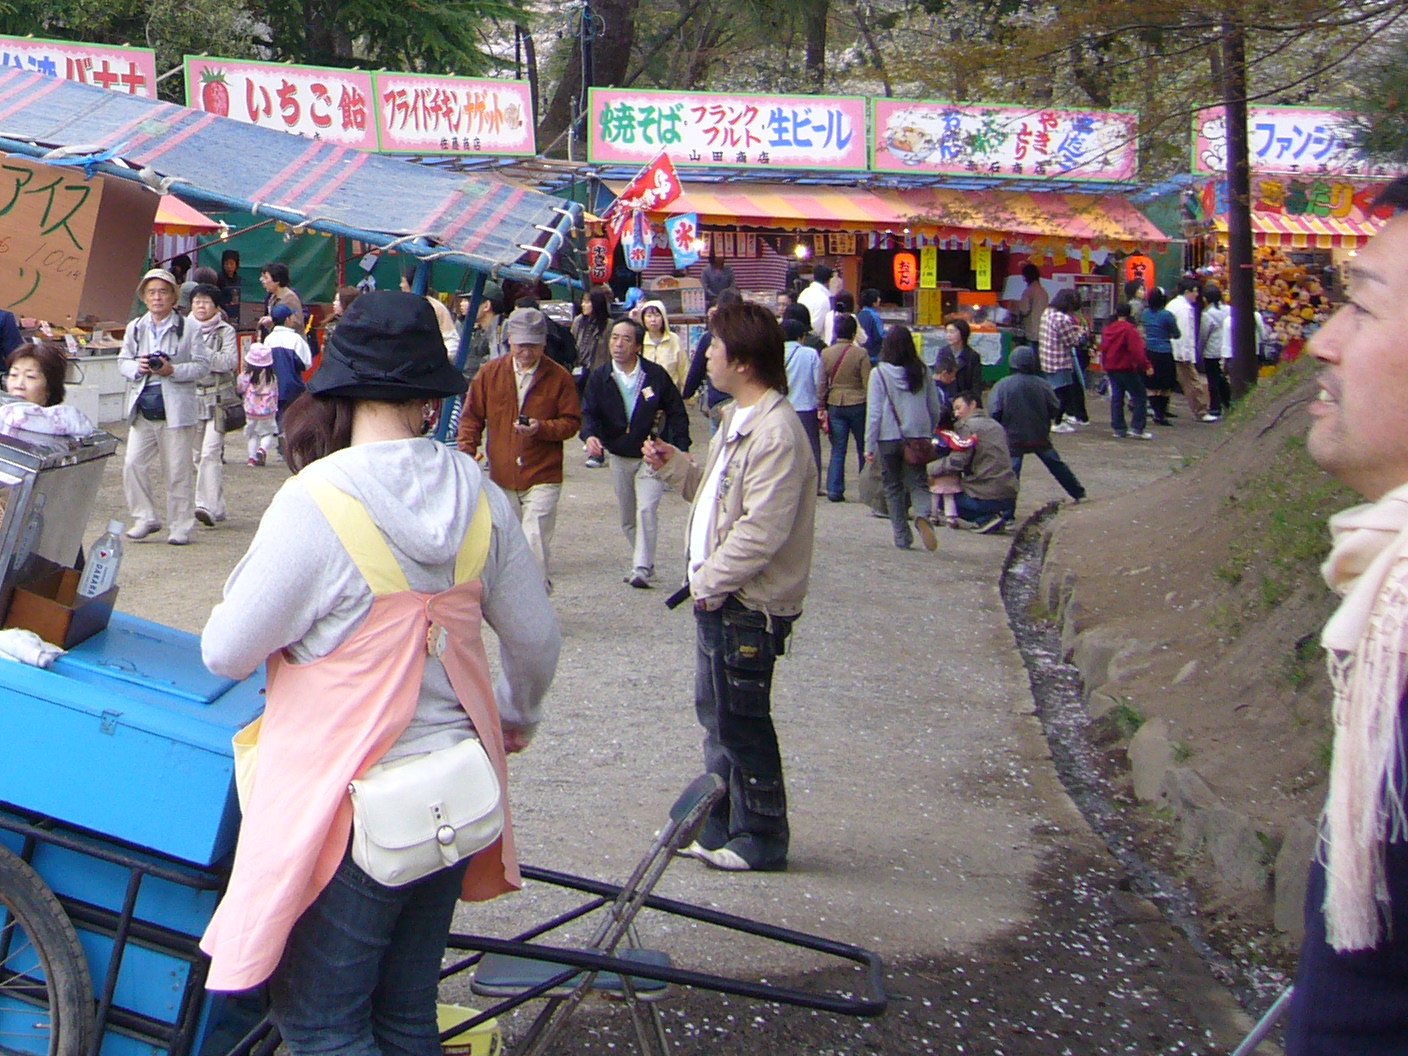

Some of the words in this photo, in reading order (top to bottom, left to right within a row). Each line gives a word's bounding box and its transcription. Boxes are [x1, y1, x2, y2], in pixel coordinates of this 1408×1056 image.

[245, 77, 368, 132] いちご飴
[599, 102, 684, 145] 焼そば
[690, 104, 760, 126] フランク
[767, 106, 854, 151] 生ビール
[702, 126, 763, 148] フルト
